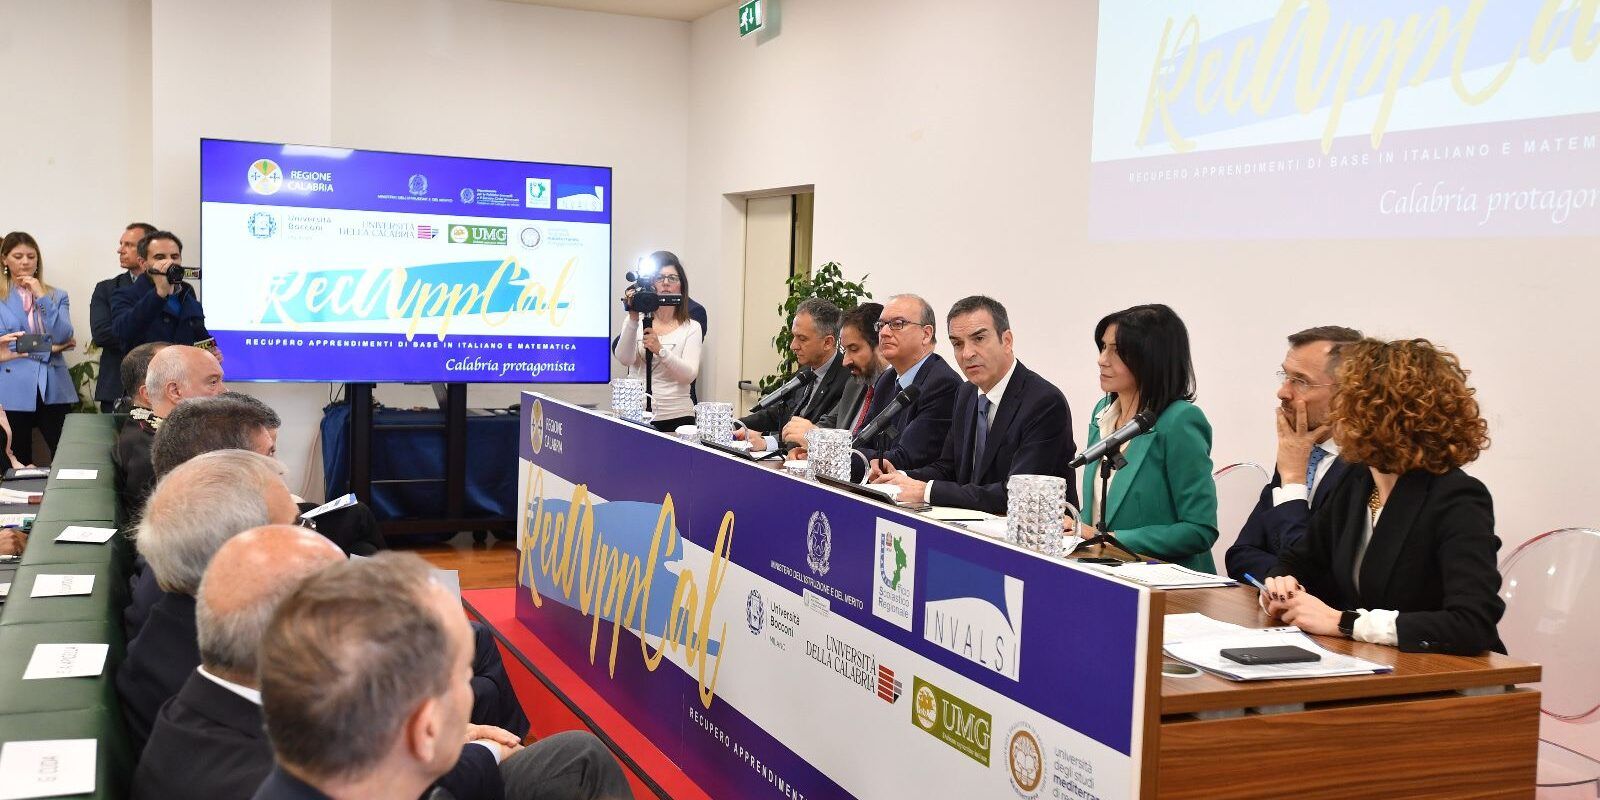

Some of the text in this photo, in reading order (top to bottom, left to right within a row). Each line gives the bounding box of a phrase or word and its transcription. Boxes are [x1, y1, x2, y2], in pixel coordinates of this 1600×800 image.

[1134, 0, 1600, 155] RecAppCa
[1129, 135, 1597, 182] RECUPERO APPRENDIMENTI DI BASE IN ITALIANO E MATEM
[288, 180, 334, 193] CALABRIA
[290, 170, 332, 182] REGIONE
[1379, 181, 1477, 215] Calabria
[472, 227, 507, 242] UMG
[245, 338, 303, 346] RECUPERO
[308, 339, 393, 348] APPRENDIMENTI
[445, 356, 576, 377] Calabria protagonista
[844, 593, 864, 610] MERITO
[878, 597, 909, 619] Regionale
[879, 586, 910, 608] Scolastico
[771, 615, 794, 638] Bocconi
[926, 606, 1017, 677] INVALSI
[826, 634, 876, 676] UNIVERSITÀ
[806, 640, 876, 694] DELLA CALABRIA
[942, 698, 990, 750] UMG
[689, 707, 808, 800] RECUPERO APPRENDIMENT
[1054, 760, 1073, 779] degli
